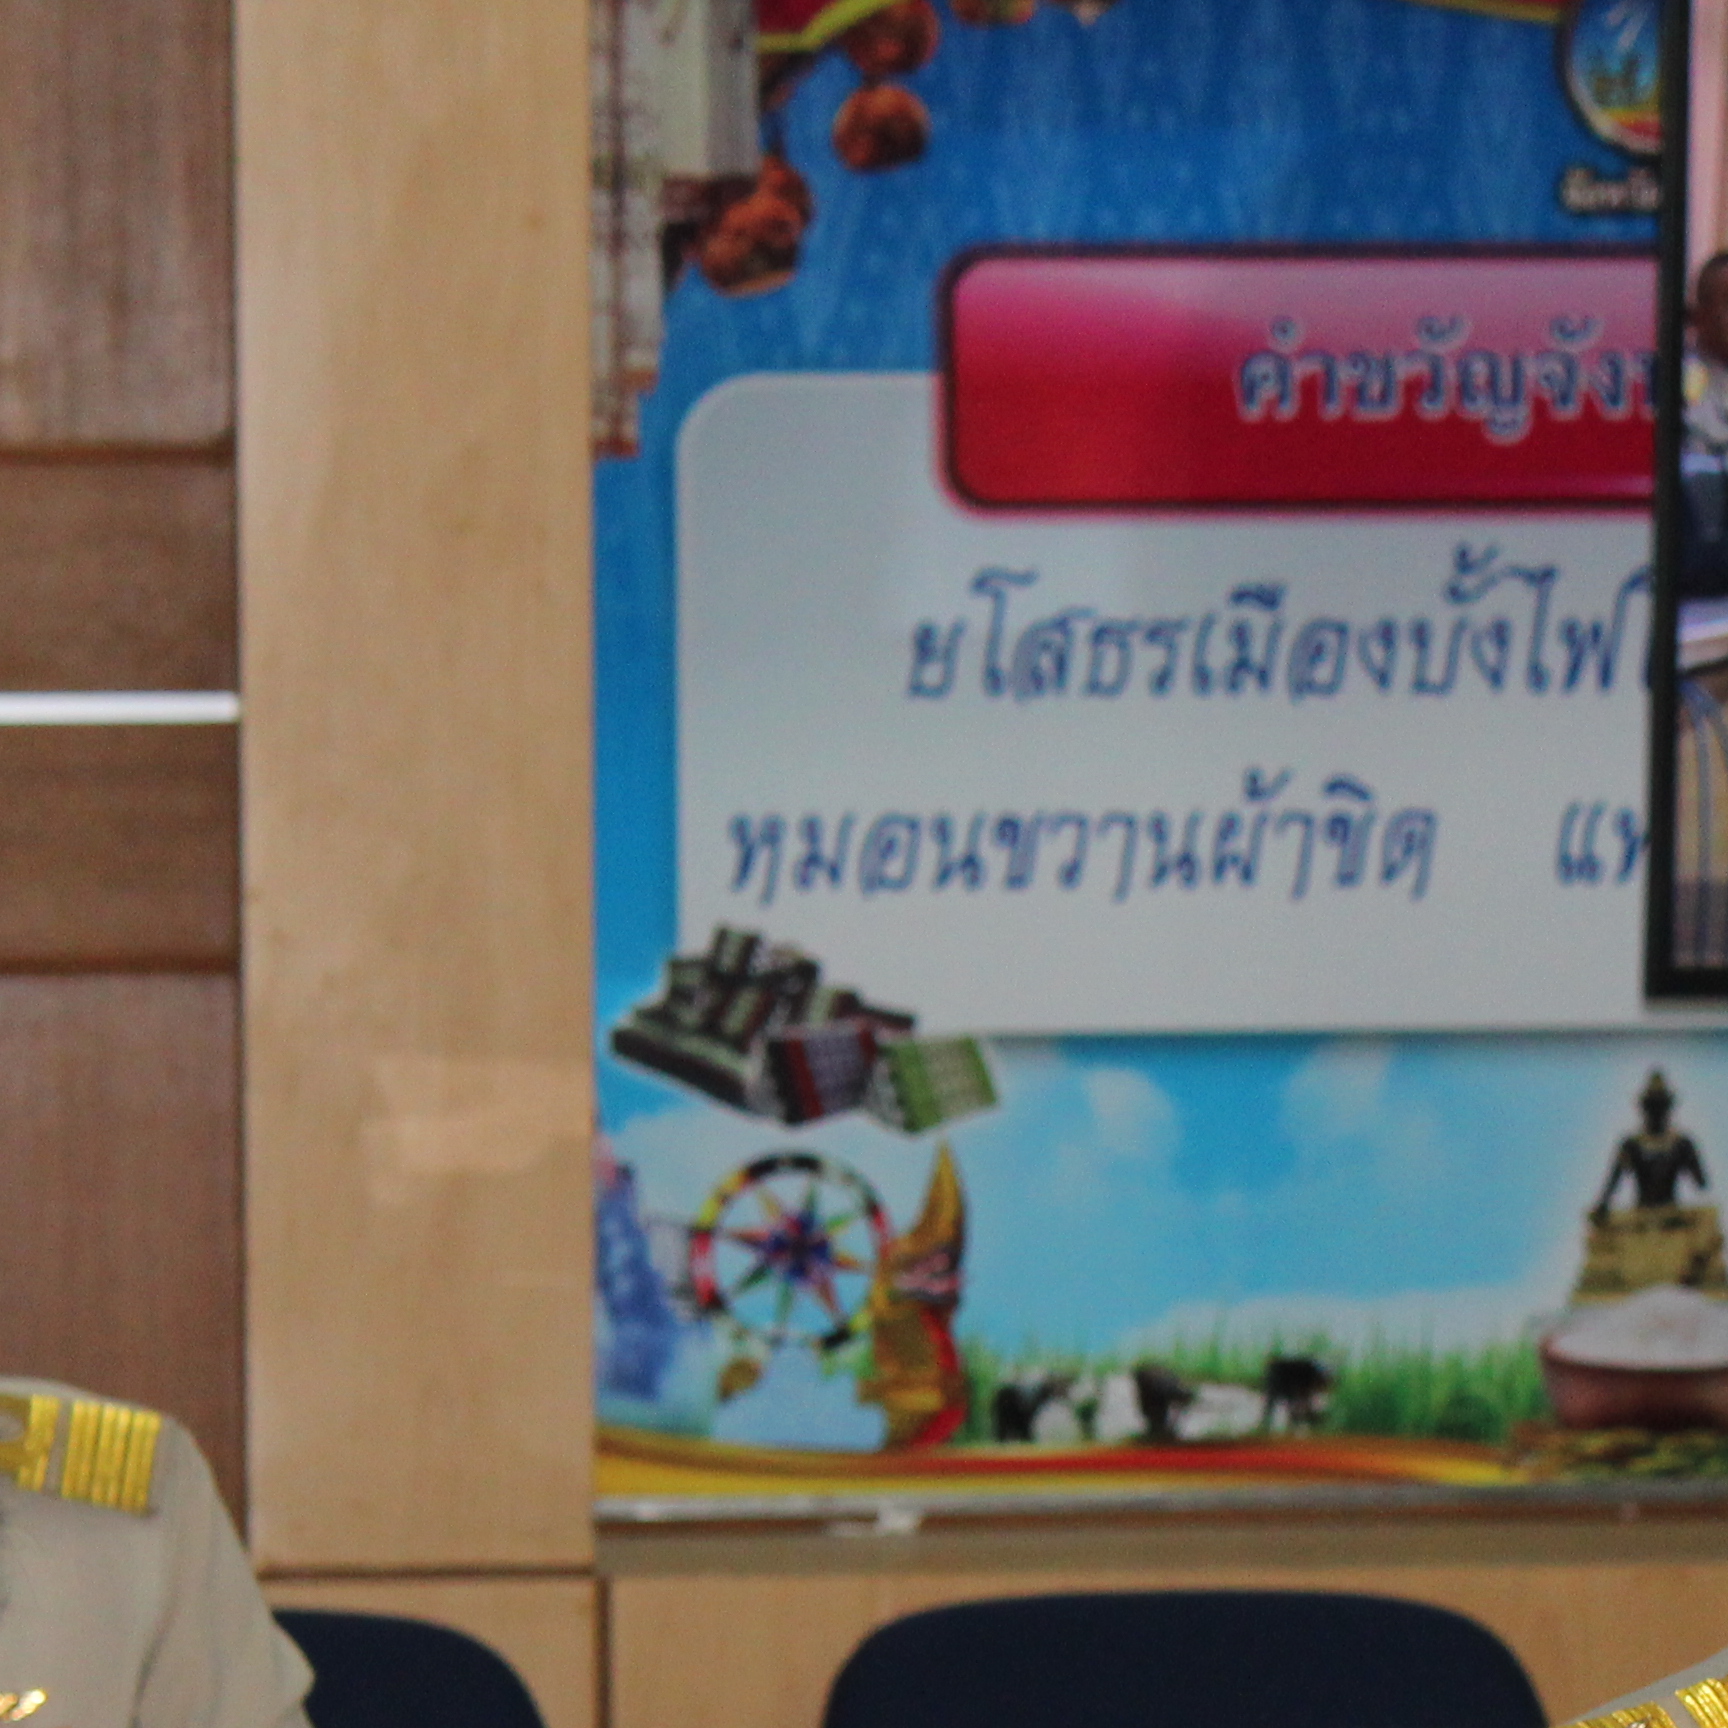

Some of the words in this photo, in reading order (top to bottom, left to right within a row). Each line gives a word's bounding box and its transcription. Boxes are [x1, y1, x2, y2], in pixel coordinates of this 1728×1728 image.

[907, 543, 1655, 700] ยโสธรเมืองบั้งไฟ
